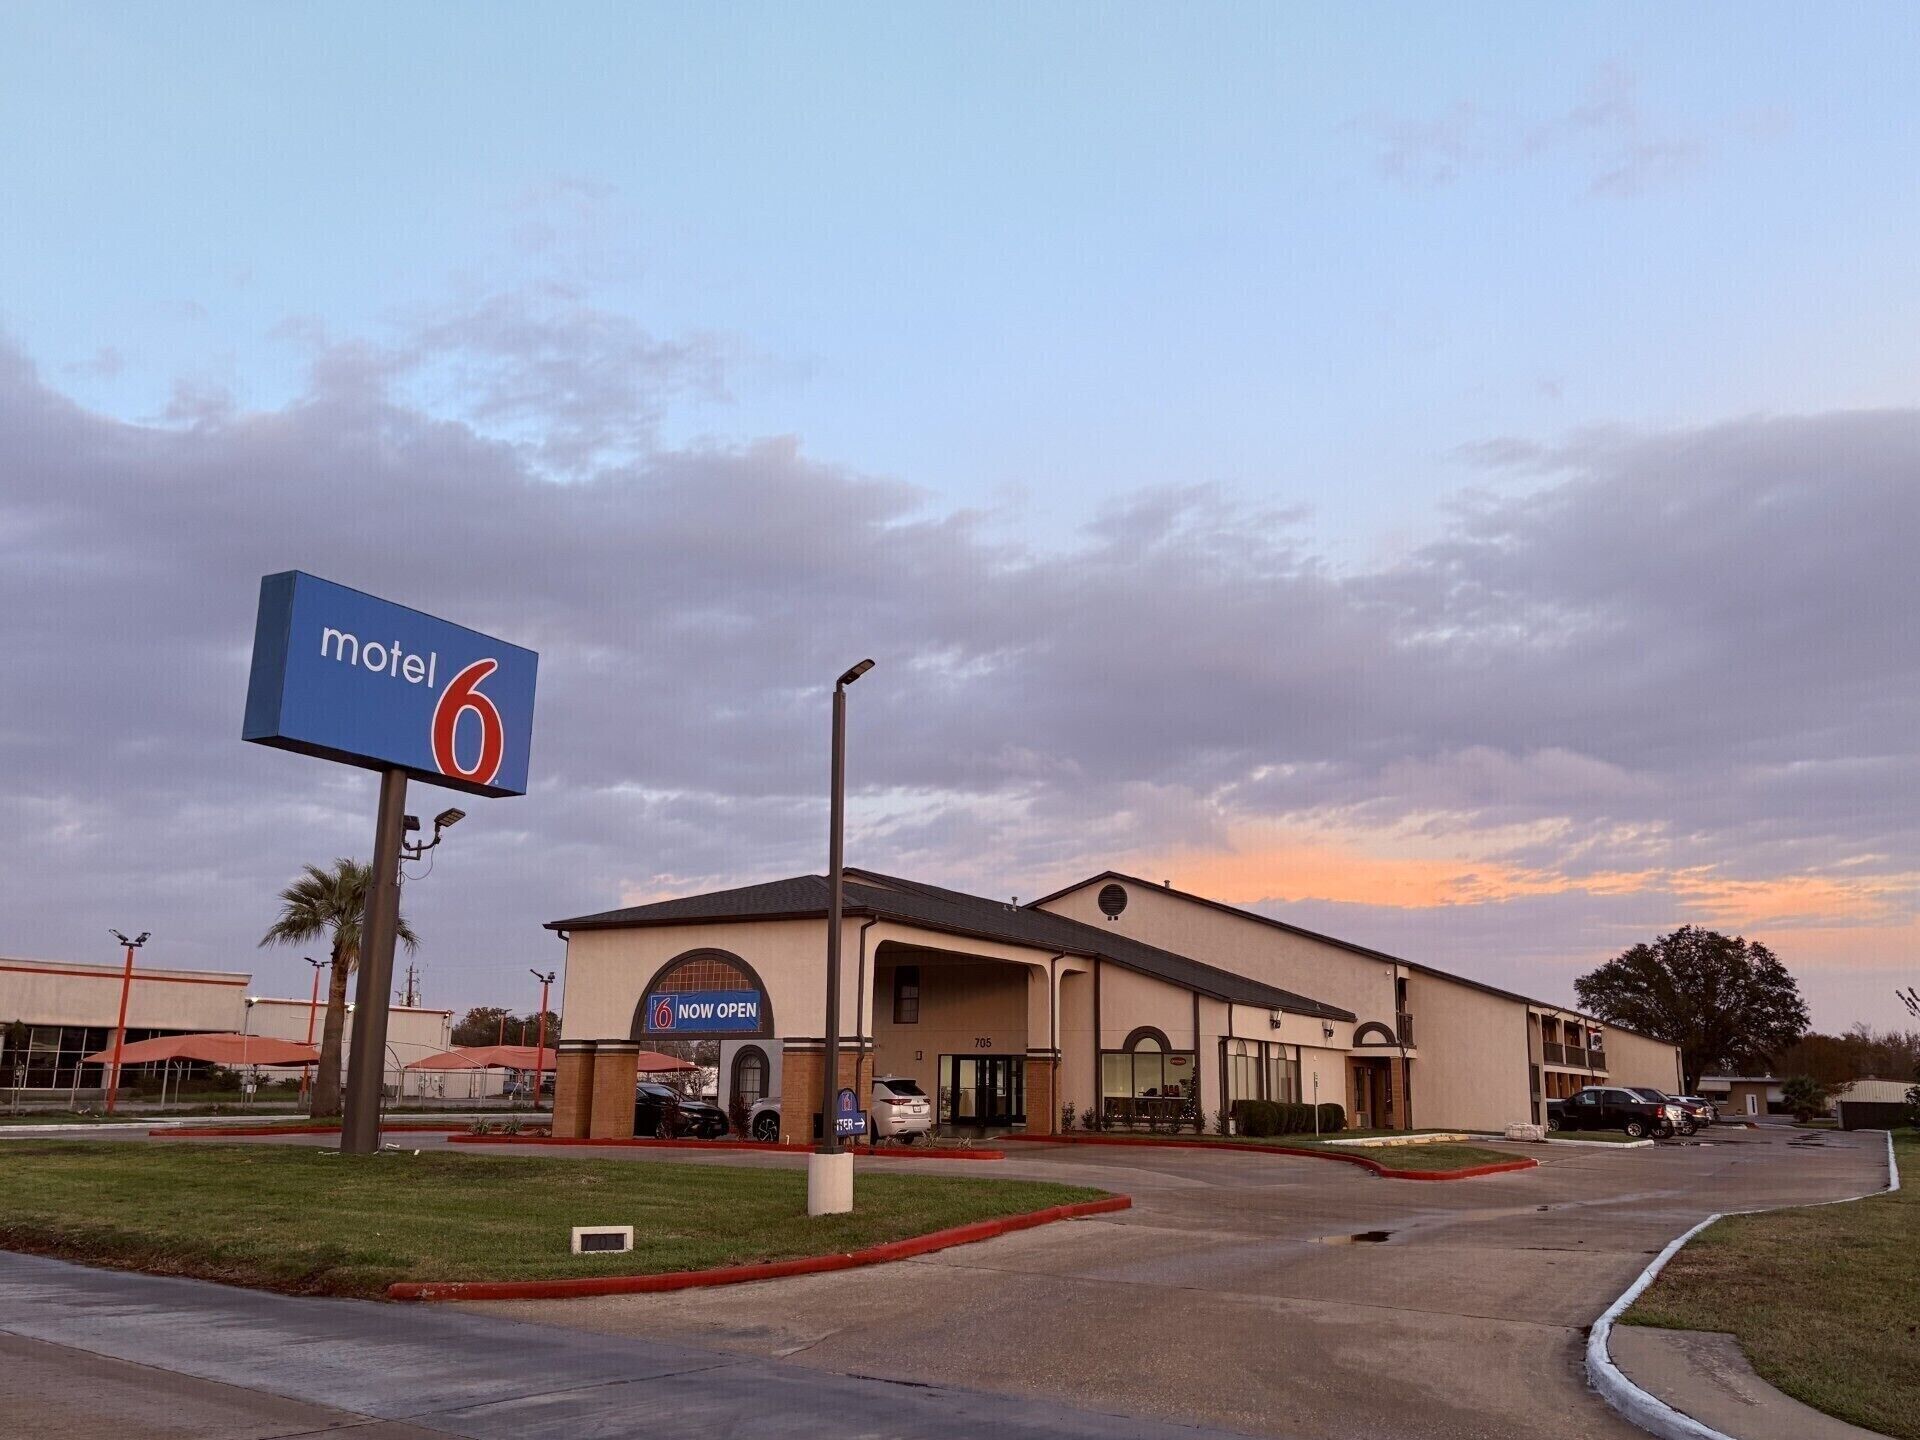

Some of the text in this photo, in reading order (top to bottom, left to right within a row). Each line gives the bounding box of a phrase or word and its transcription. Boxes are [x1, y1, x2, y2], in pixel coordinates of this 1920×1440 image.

[321, 626, 504, 786] motel 6
[655, 997, 673, 1029] 6
[678, 1003, 714, 1019] NOW
[717, 1002, 757, 1018] OPEN
[974, 1037, 992, 1048] 705
